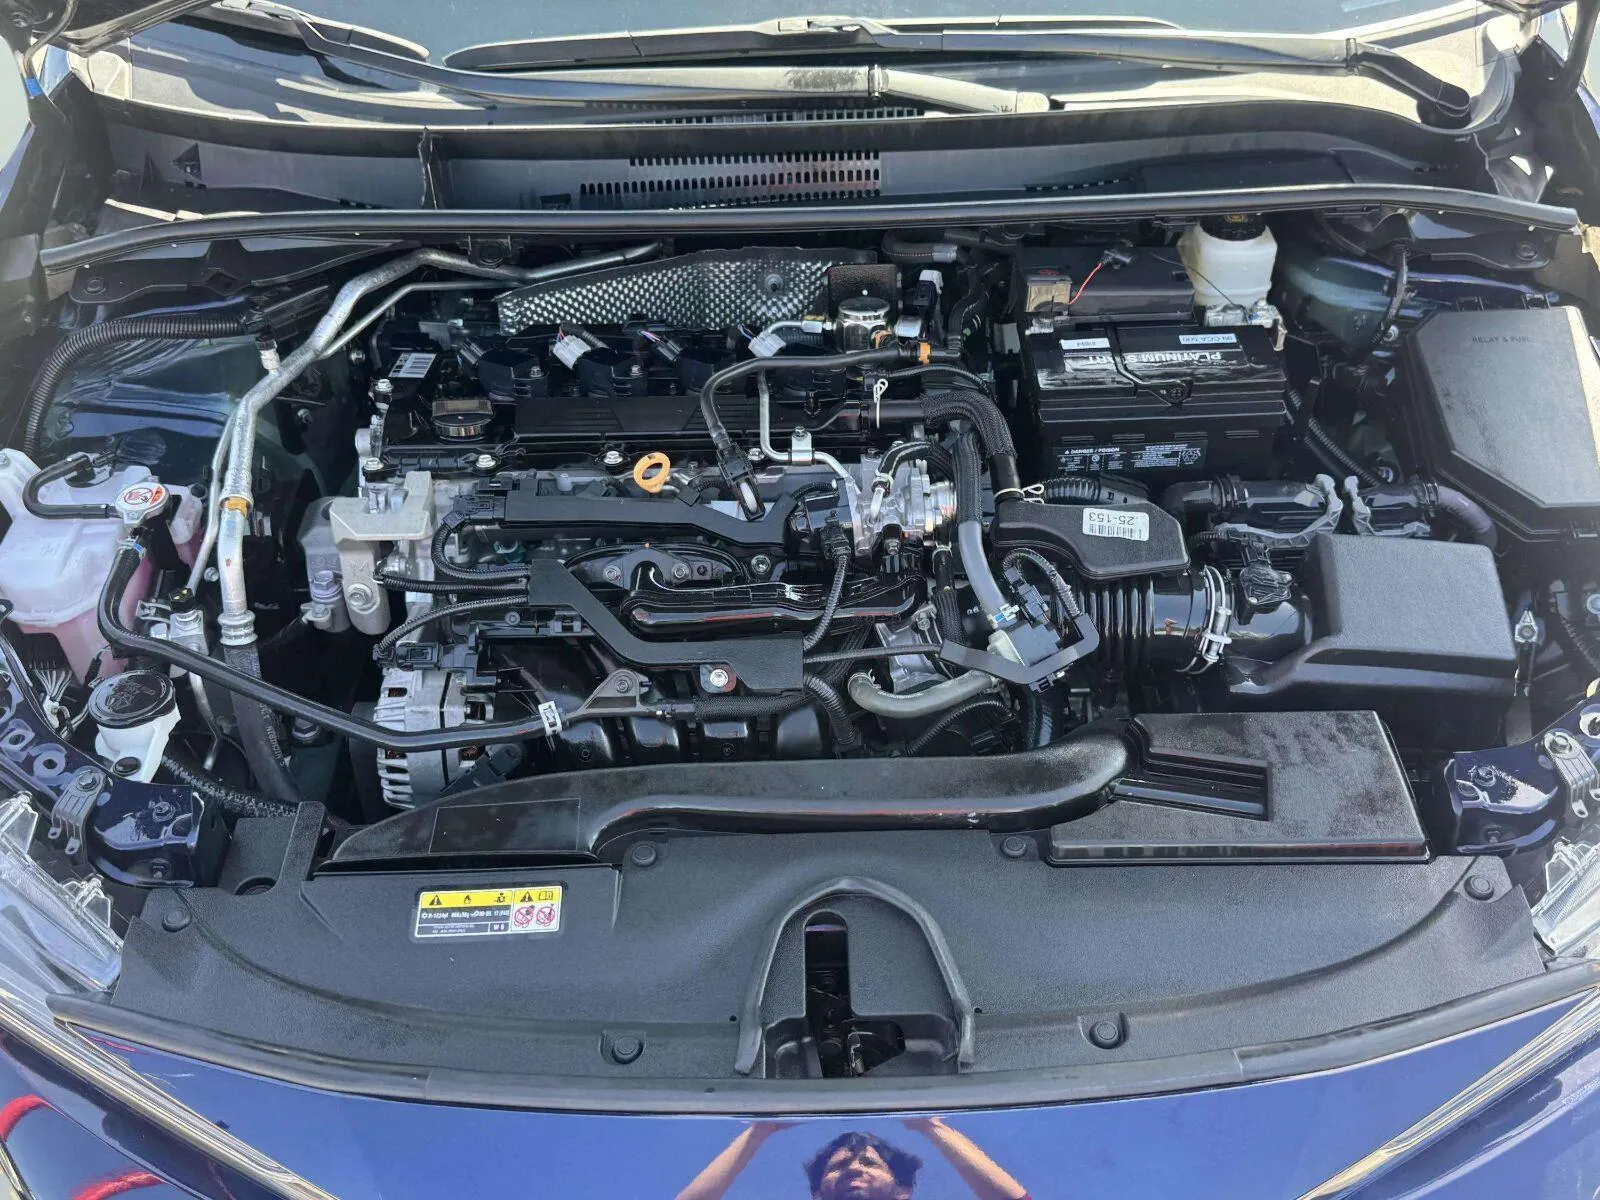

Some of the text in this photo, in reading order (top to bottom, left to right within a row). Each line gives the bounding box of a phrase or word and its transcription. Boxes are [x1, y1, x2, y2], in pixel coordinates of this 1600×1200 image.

[1472, 335, 1499, 344] RELAY
[1087, 352, 1222, 364] PLATINUM SART
